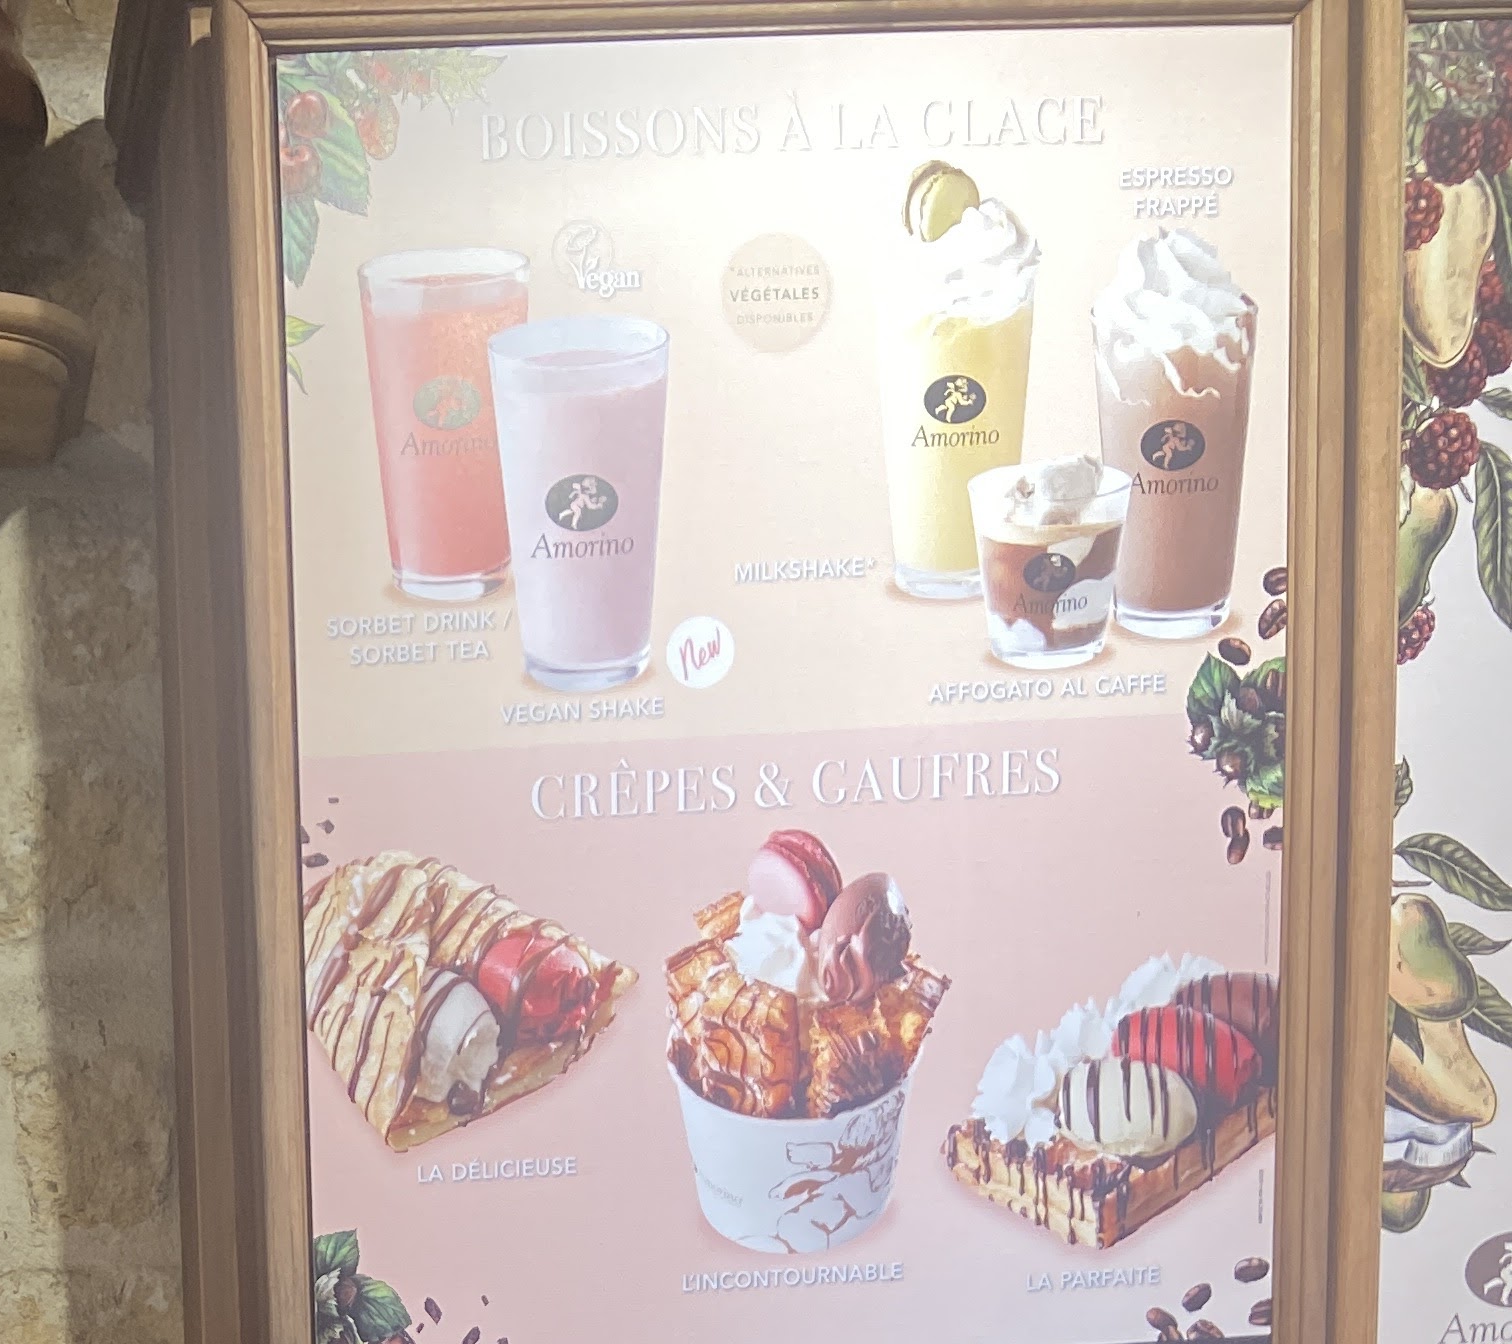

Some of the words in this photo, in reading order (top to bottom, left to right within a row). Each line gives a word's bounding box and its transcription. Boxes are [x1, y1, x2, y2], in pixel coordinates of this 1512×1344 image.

[480, 104, 760, 162] BOISSONS
[831, 102, 902, 151] LA
[1119, 166, 1234, 188] ESPRESSO
[1133, 190, 1219, 217] FRAPPÉ
[569, 255, 642, 298] Vegan
[729, 285, 820, 302] VÉGÉTALES
[737, 312, 814, 325] DISPONIBLES
[911, 424, 1000, 448] Amorino
[1131, 471, 1220, 496] Amorino
[530, 531, 635, 560] Amorino
[1013, 592, 1088, 616] Amorino
[327, 612, 416, 639] SORBET
[423, 608, 495, 635] DRINK
[350, 641, 440, 667] SORBET
[446, 639, 490, 662] TEA
[678, 625, 722, 681] New
[928, 678, 1055, 705] AFFOGATO
[1059, 675, 1089, 697] AL
[499, 700, 582, 726] VEGAN
[587, 696, 665, 721] SHAKE
[530, 757, 736, 820] CRÊPES
[753, 761, 792, 809] &
[811, 747, 1062, 806] GAUFRES
[417, 1163, 444, 1184] LA
[452, 1156, 578, 1181] DÉLICIEUSE
[681, 1261, 904, 1293] L'INCONTOURNABLE
[1026, 1272, 1053, 1292] LA
[1060, 1266, 1161, 1290] PARFAITE
